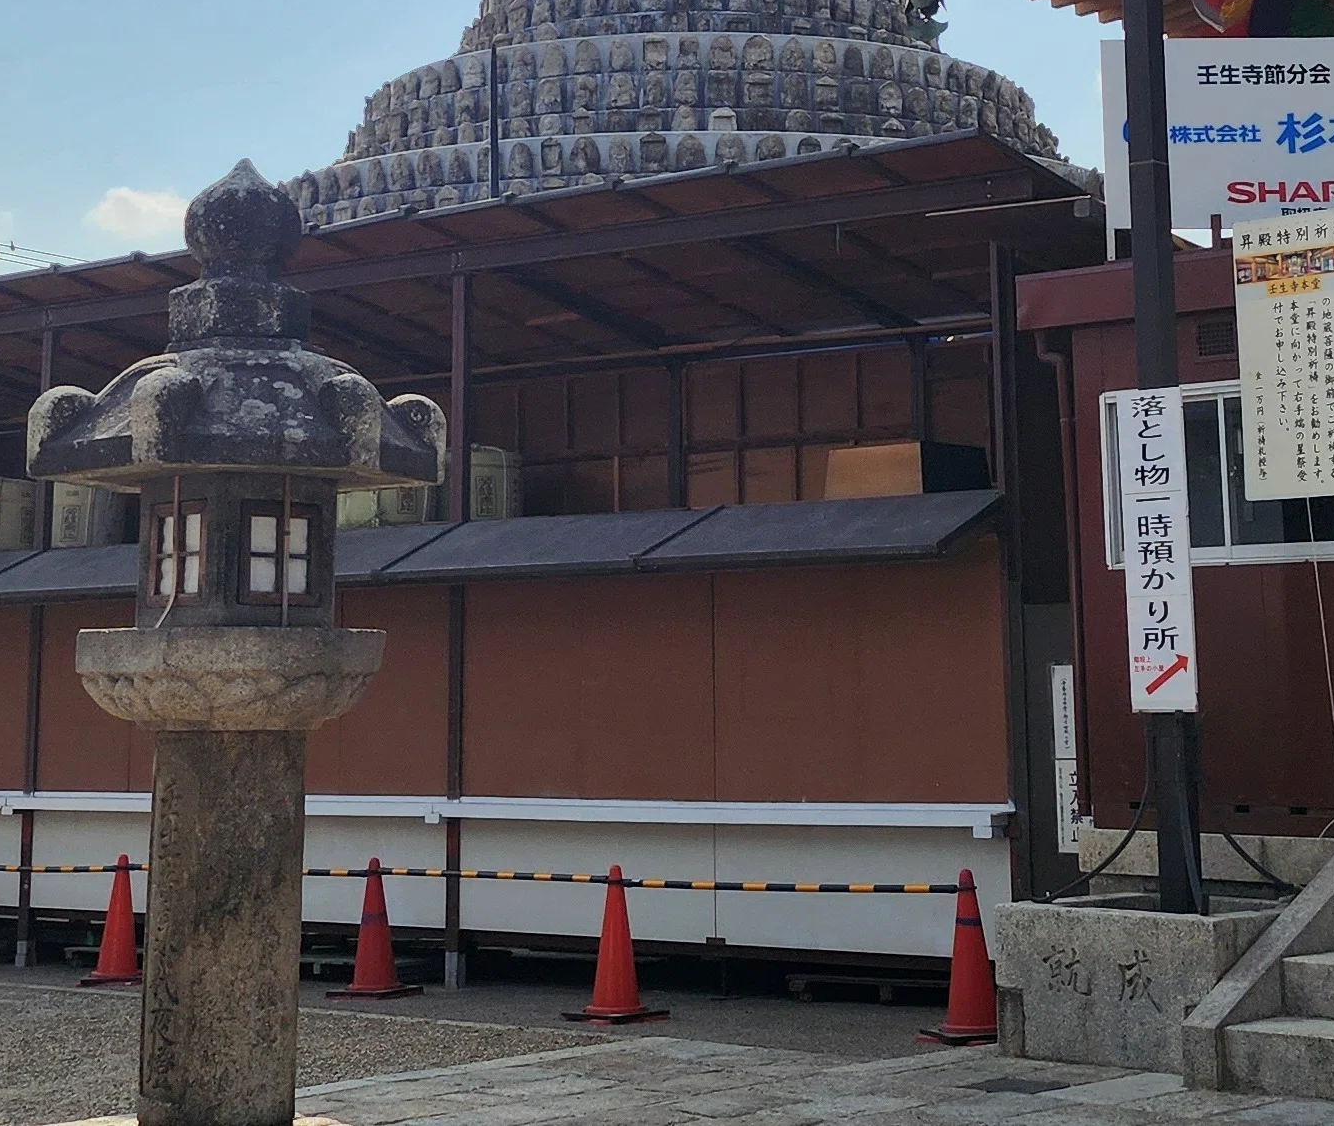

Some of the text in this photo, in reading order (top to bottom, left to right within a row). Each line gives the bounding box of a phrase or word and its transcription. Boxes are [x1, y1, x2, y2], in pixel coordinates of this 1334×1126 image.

[1197, 63, 1331, 85] 壬生寺節分会
[1169, 124, 1262, 144] 株式会社
[1267, 277, 1321, 295] 壬生寺本堂
[1130, 394, 1180, 651] 落とし物一時預かり所
